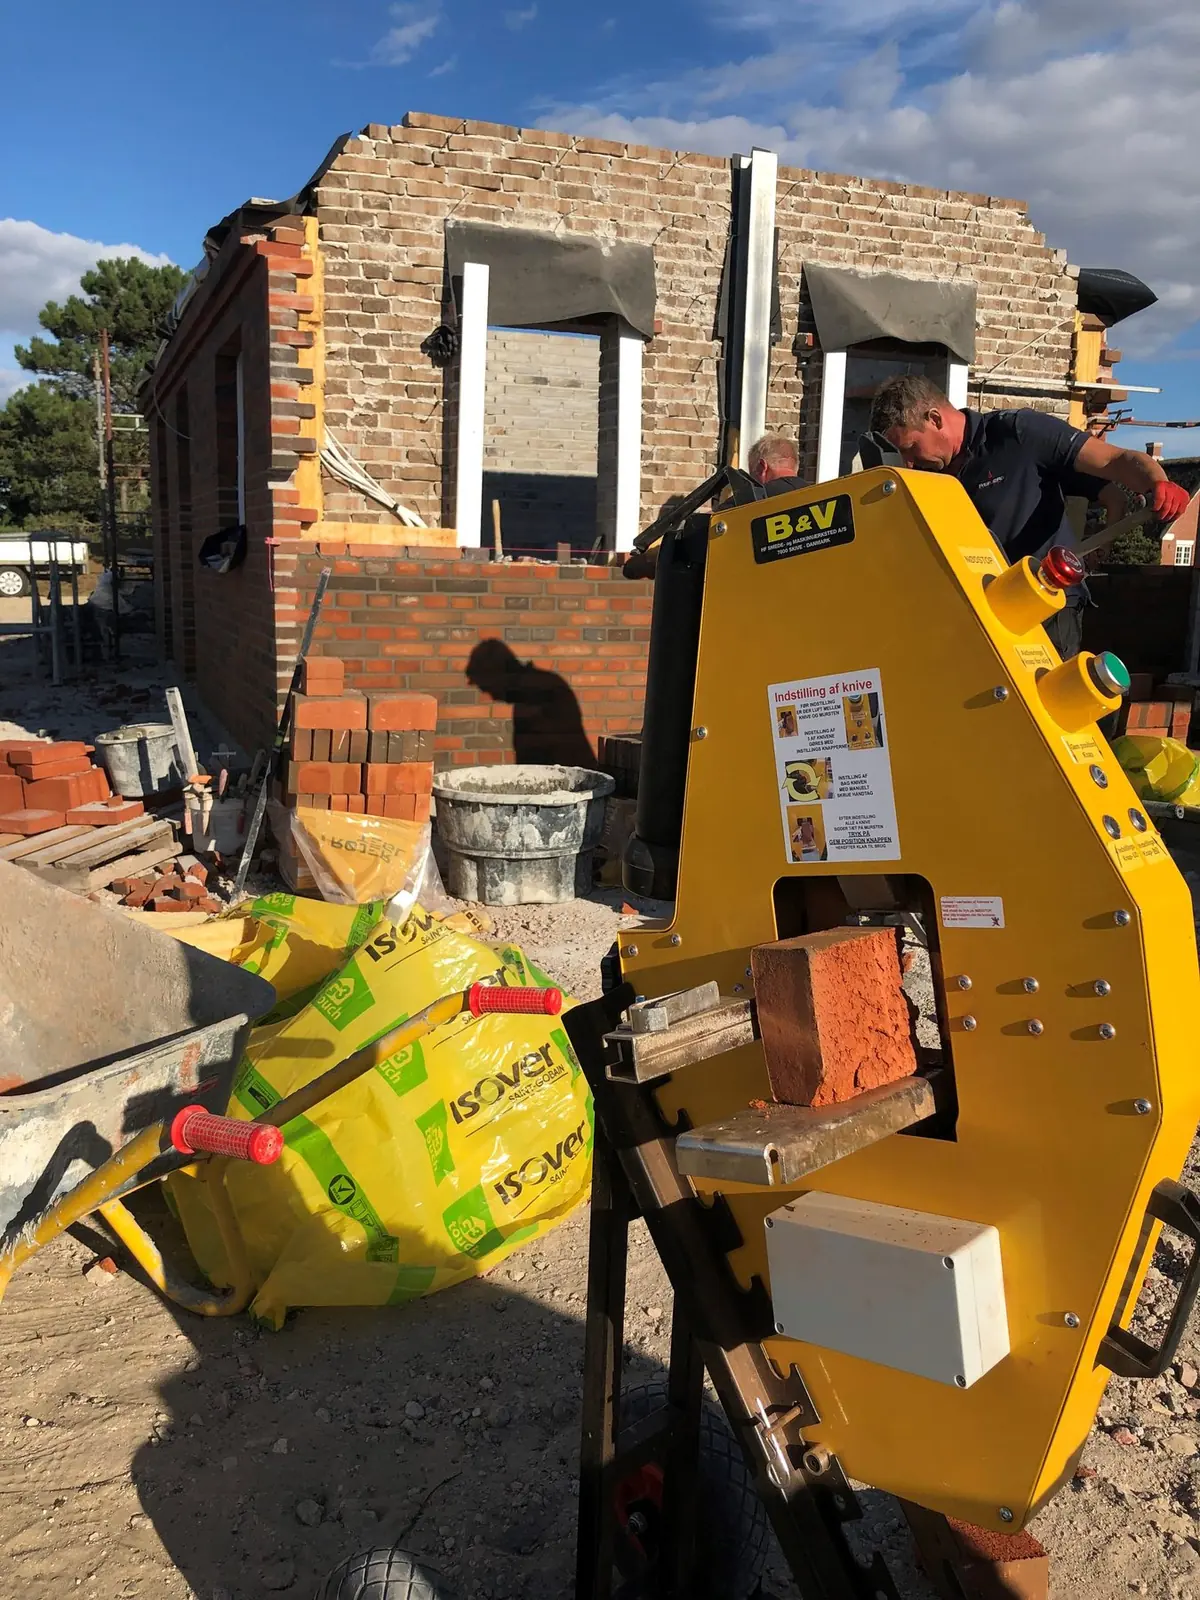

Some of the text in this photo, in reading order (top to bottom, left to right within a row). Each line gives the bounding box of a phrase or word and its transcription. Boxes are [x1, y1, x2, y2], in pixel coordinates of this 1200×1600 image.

[766, 500, 837, 542] B&V
[774, 680, 872, 702] Indstilling af knive
[317, 996, 342, 1020] ouch
[380, 1060, 402, 1084] uch
[508, 1064, 566, 1102] SAINT-GOBAIN
